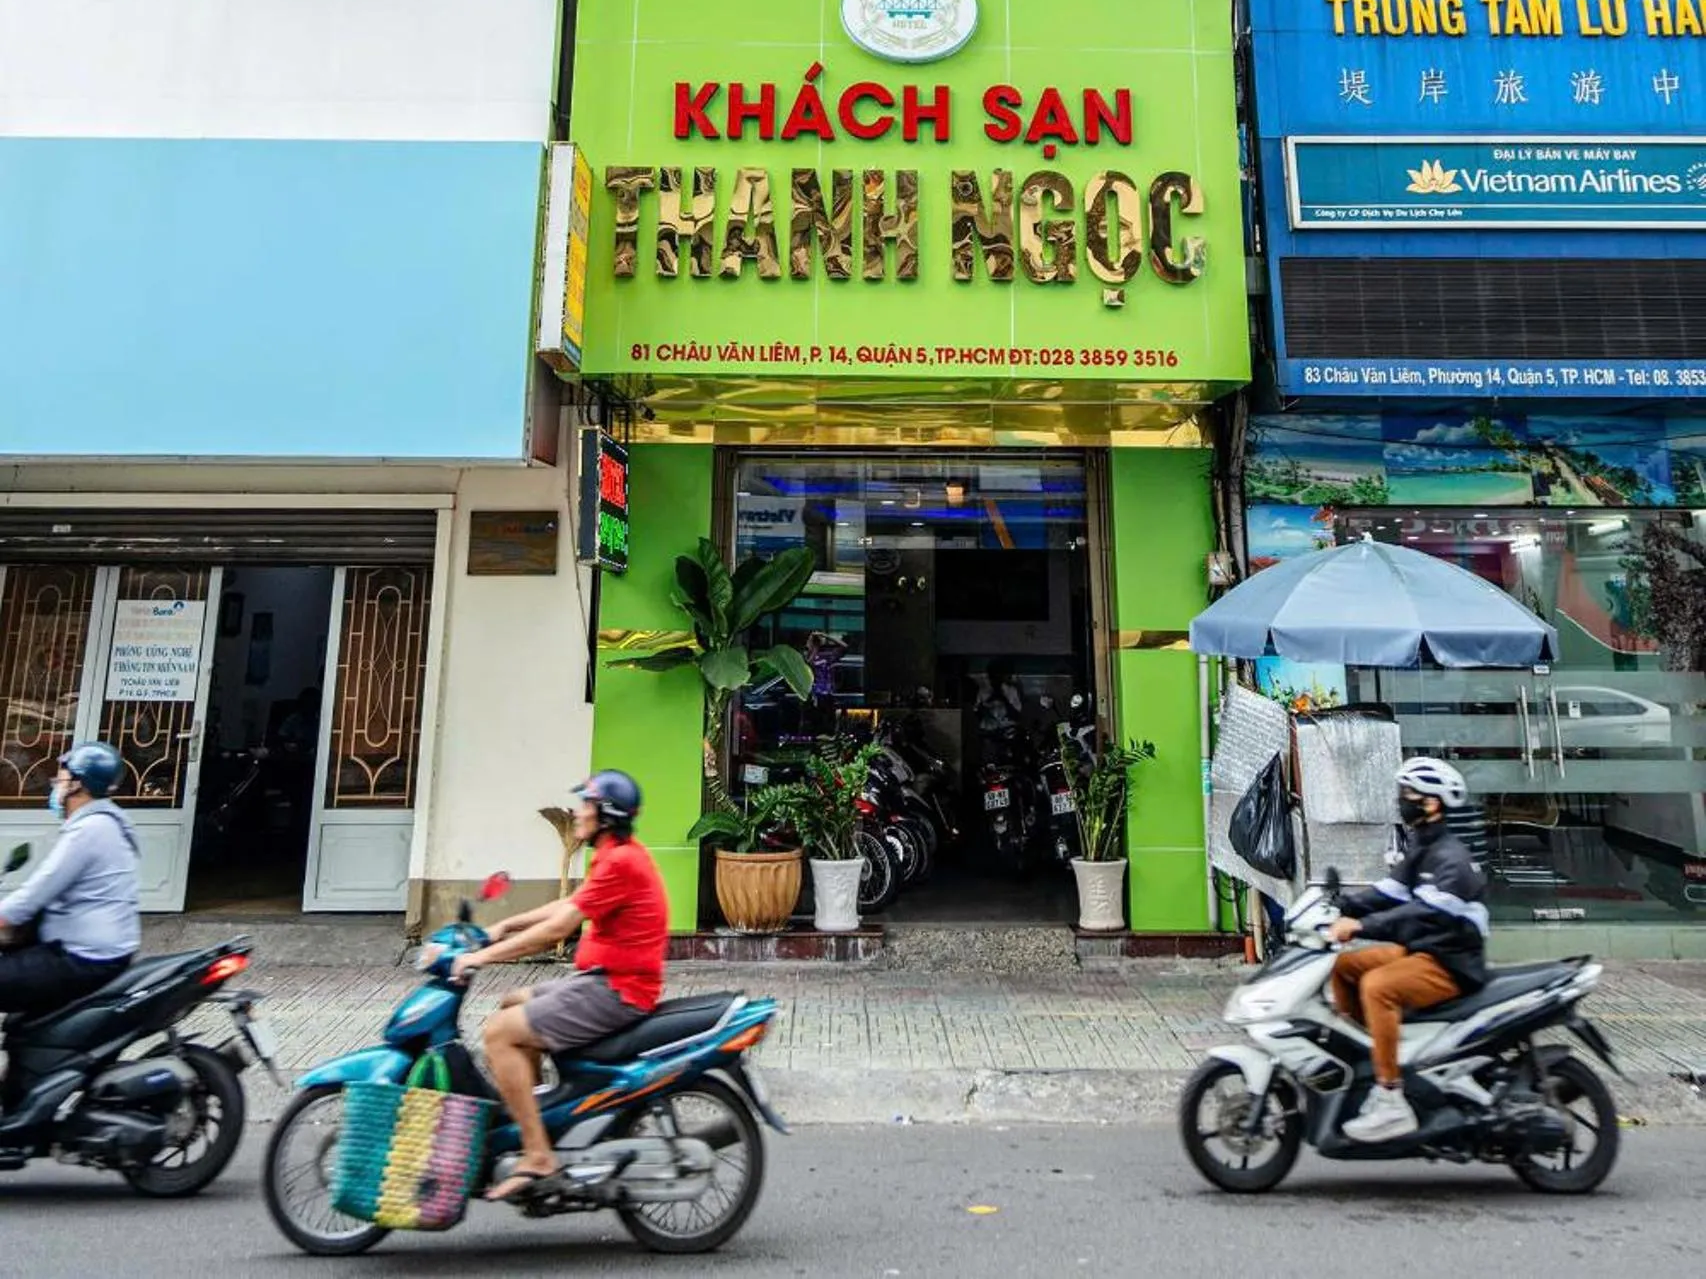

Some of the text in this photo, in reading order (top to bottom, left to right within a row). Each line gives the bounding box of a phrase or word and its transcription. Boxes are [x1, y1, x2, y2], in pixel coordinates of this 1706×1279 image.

[674, 61, 1133, 158] KHÁCH SẠN
[1461, 168, 1682, 194] Vietnam Airlines
[604, 165, 919, 280] THANH
[951, 168, 1208, 307] NGỌC
[631, 344, 650, 361] 81
[656, 340, 712, 362] CHÂU
[716, 341, 755, 362] VĂN
[829, 346, 852, 365] 14,
[856, 343, 912, 368] QUẬN
[1080, 349, 1128, 366] 3859
[1133, 350, 1178, 367] 3516
[1305, 368, 1321, 383] 83
[1324, 367, 1359, 384] Châu
[1560, 369, 1581, 385] TP.
[1584, 368, 1617, 385] HCM
[1626, 369, 1651, 385] Tel:
